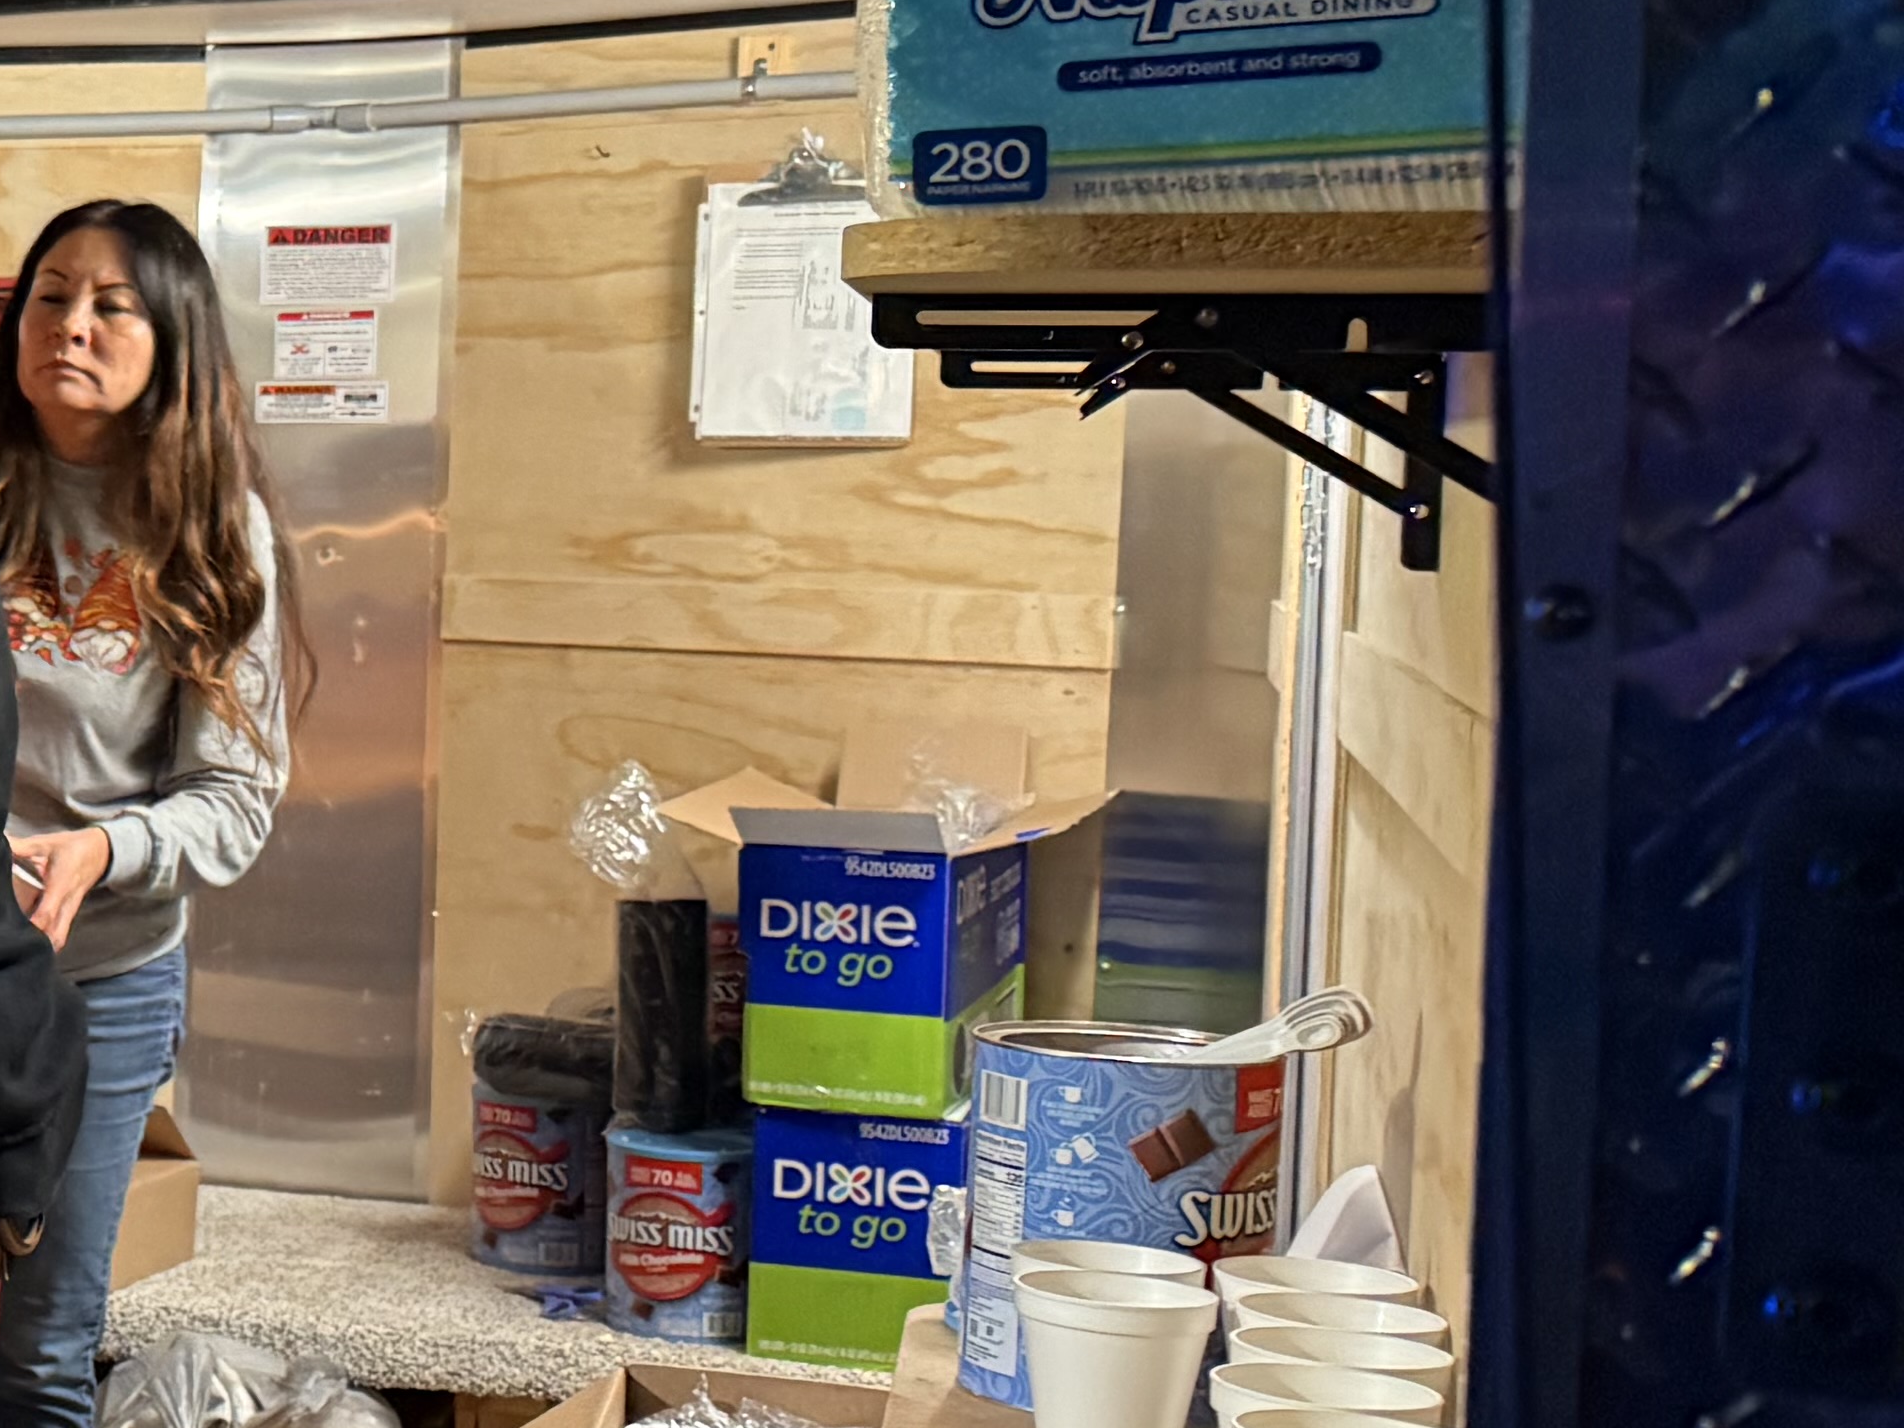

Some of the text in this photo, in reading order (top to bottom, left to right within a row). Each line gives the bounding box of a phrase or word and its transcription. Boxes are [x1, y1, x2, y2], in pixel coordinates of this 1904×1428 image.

[1185, 3, 1298, 24] CASUAL
[1078, 49, 1361, 84] soft, absorbent and strong
[929, 139, 1030, 183] 280
[293, 225, 390, 245] DANGER
[784, 943, 894, 987] to go
[651, 1168, 673, 1186] 70
[797, 1203, 907, 1249] to go
